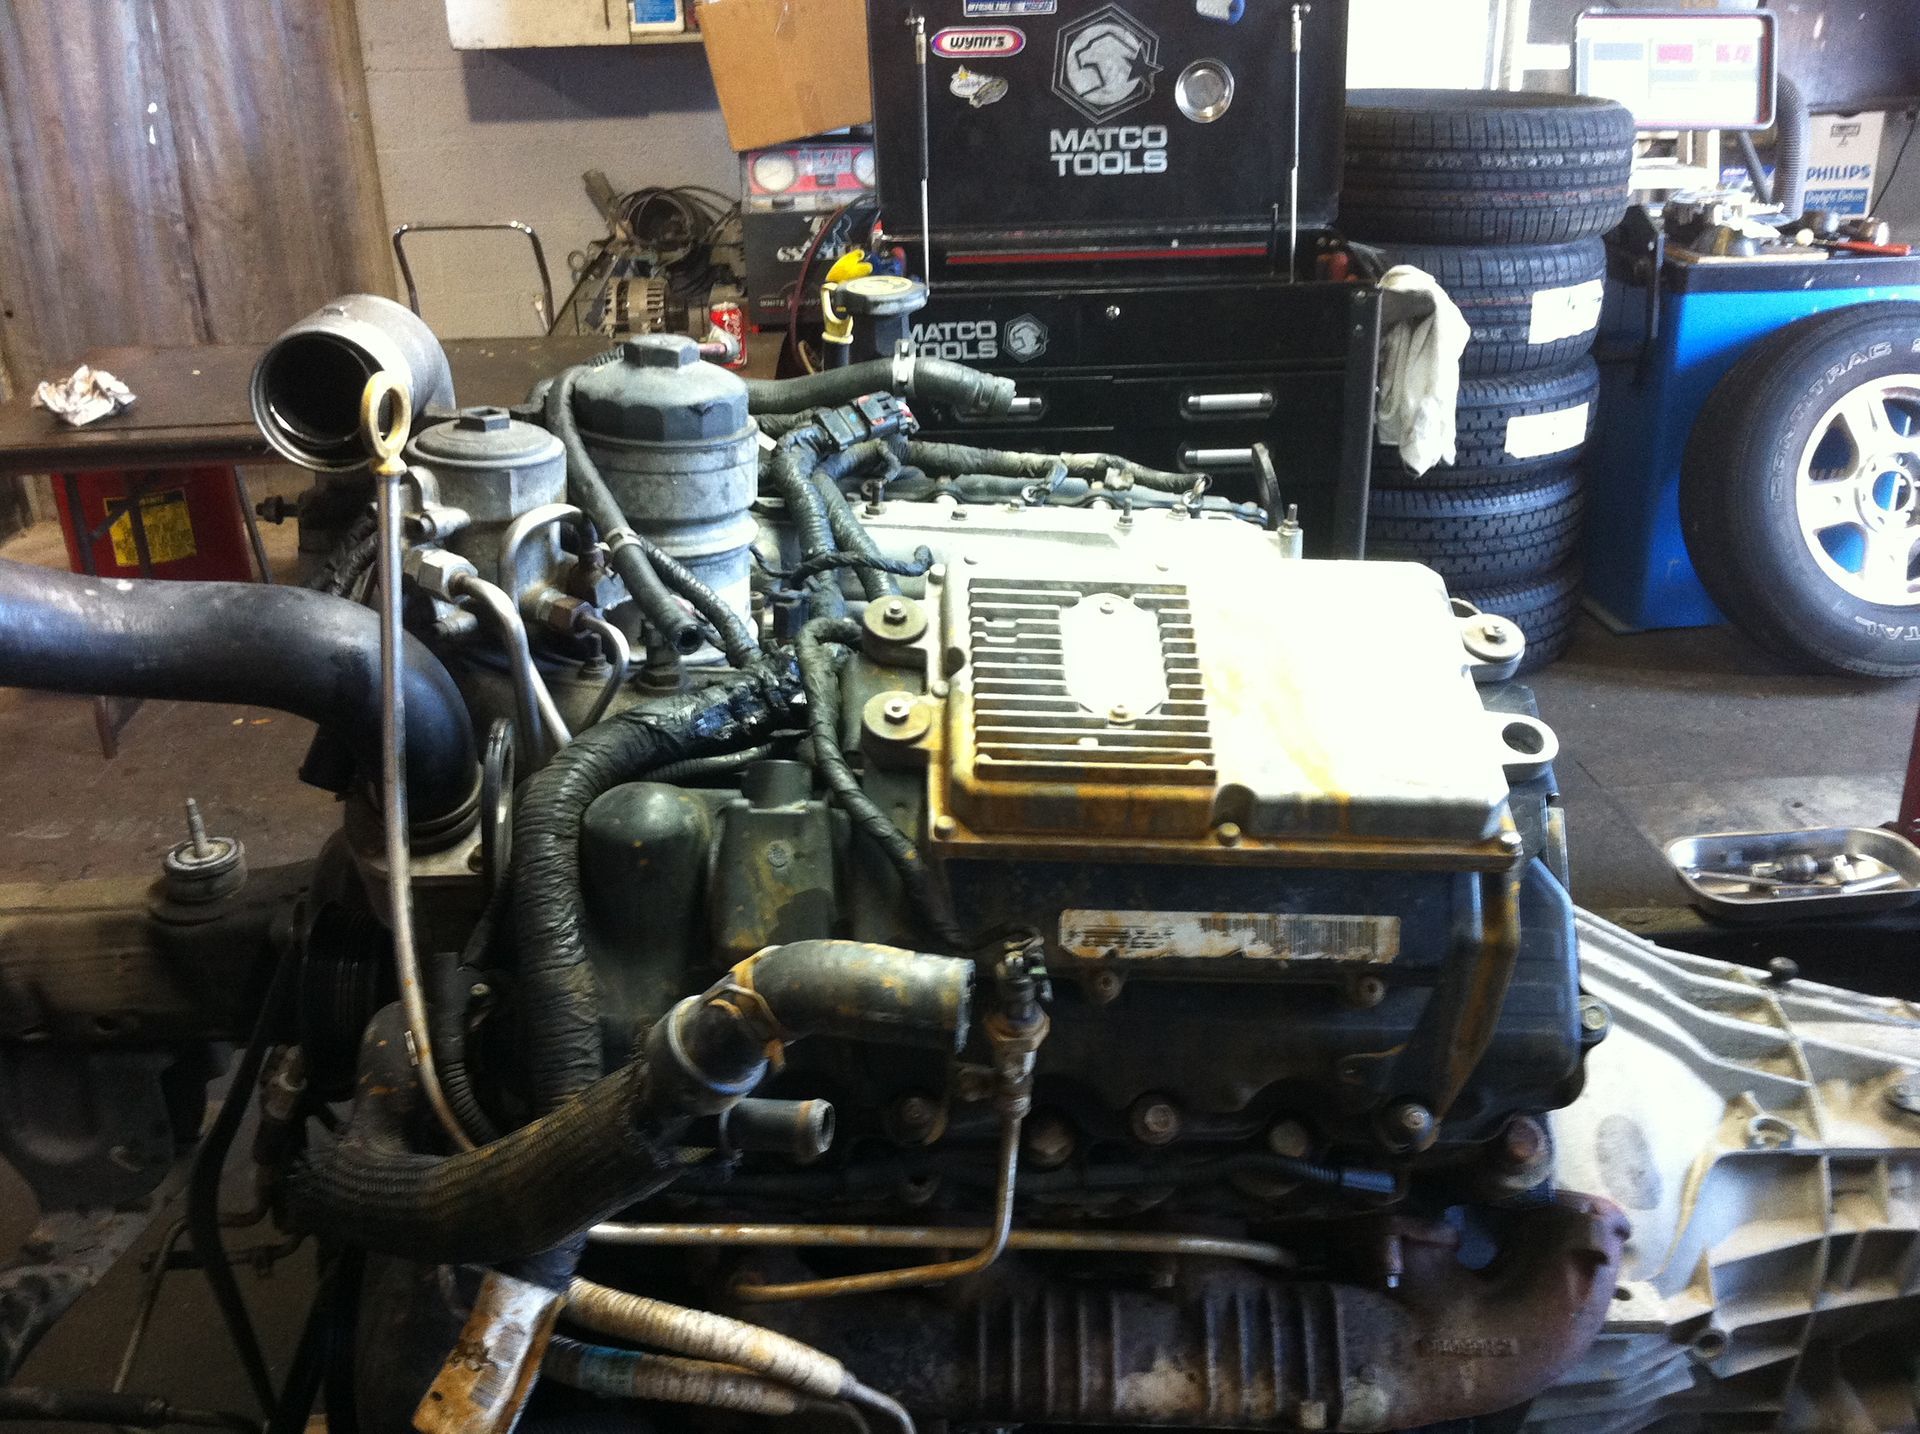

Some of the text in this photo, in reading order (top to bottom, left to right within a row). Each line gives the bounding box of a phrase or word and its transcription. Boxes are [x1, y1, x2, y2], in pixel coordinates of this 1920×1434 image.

[1050, 125, 1168, 152] MATCO
[1050, 150, 1168, 176] TOOLS
[1806, 164, 1871, 182] PHILIPS
[915, 340, 999, 361] OOLS
